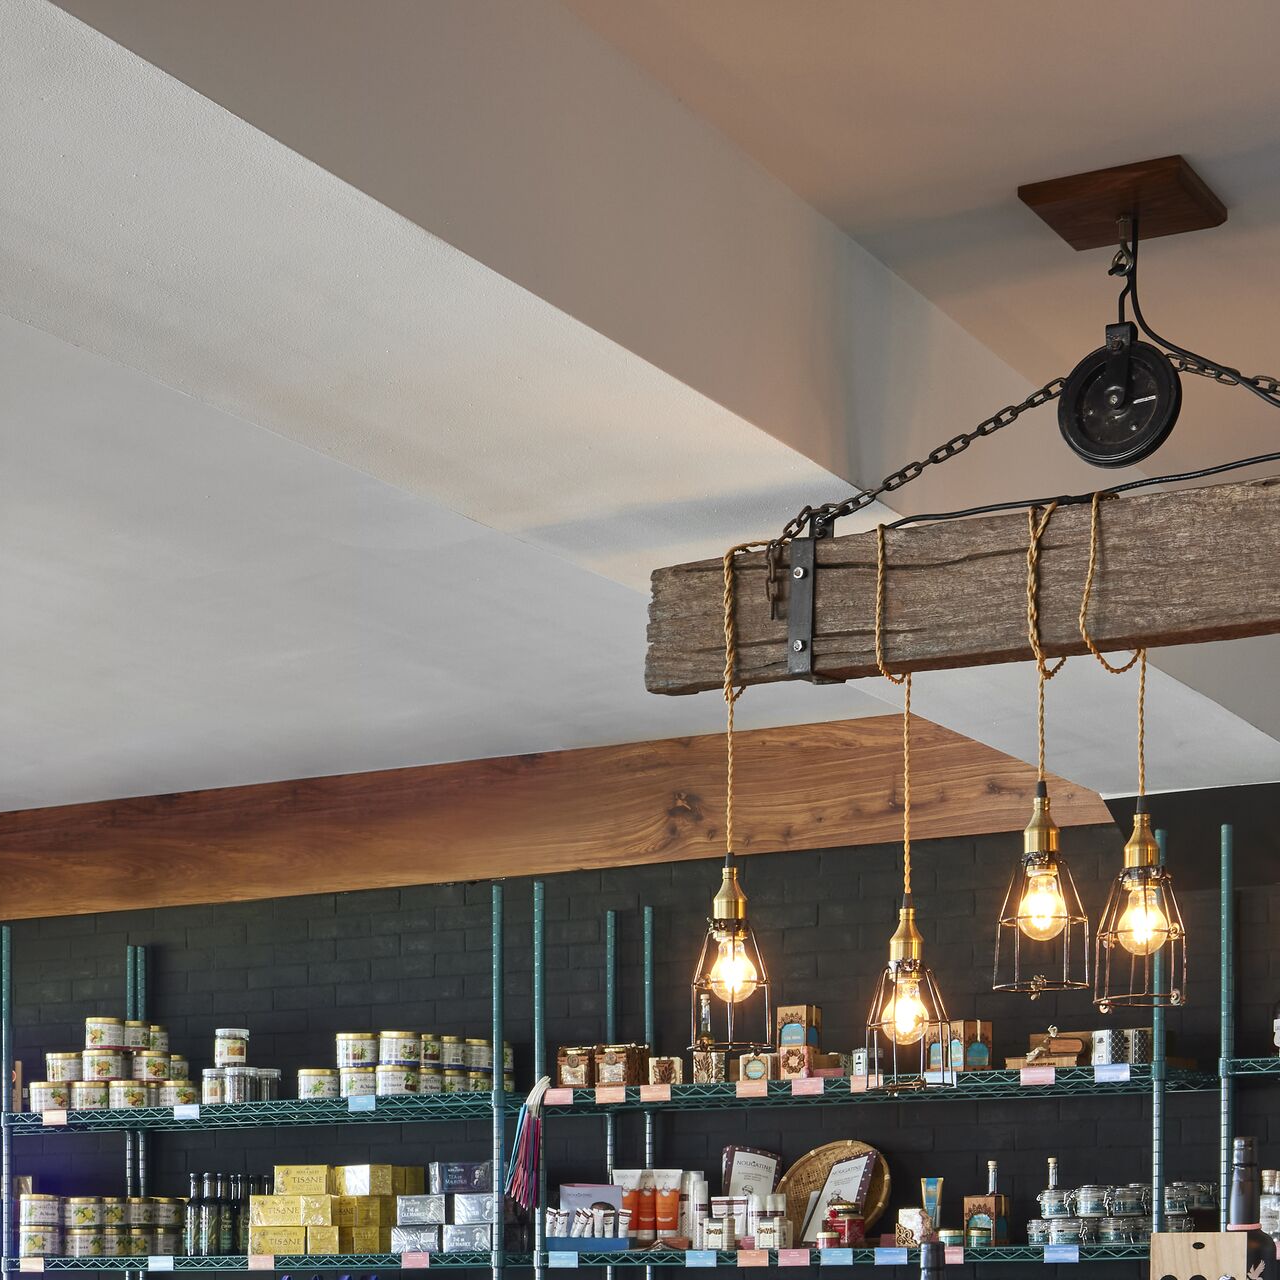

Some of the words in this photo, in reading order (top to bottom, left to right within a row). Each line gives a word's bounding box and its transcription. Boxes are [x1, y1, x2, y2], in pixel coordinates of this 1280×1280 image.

[736, 1159, 773, 1174] NOUGATINE
[291, 1175, 324, 1184] TISANE
[267, 1206, 300, 1215] TISANE
[269, 1237, 303, 1246] TISANE
